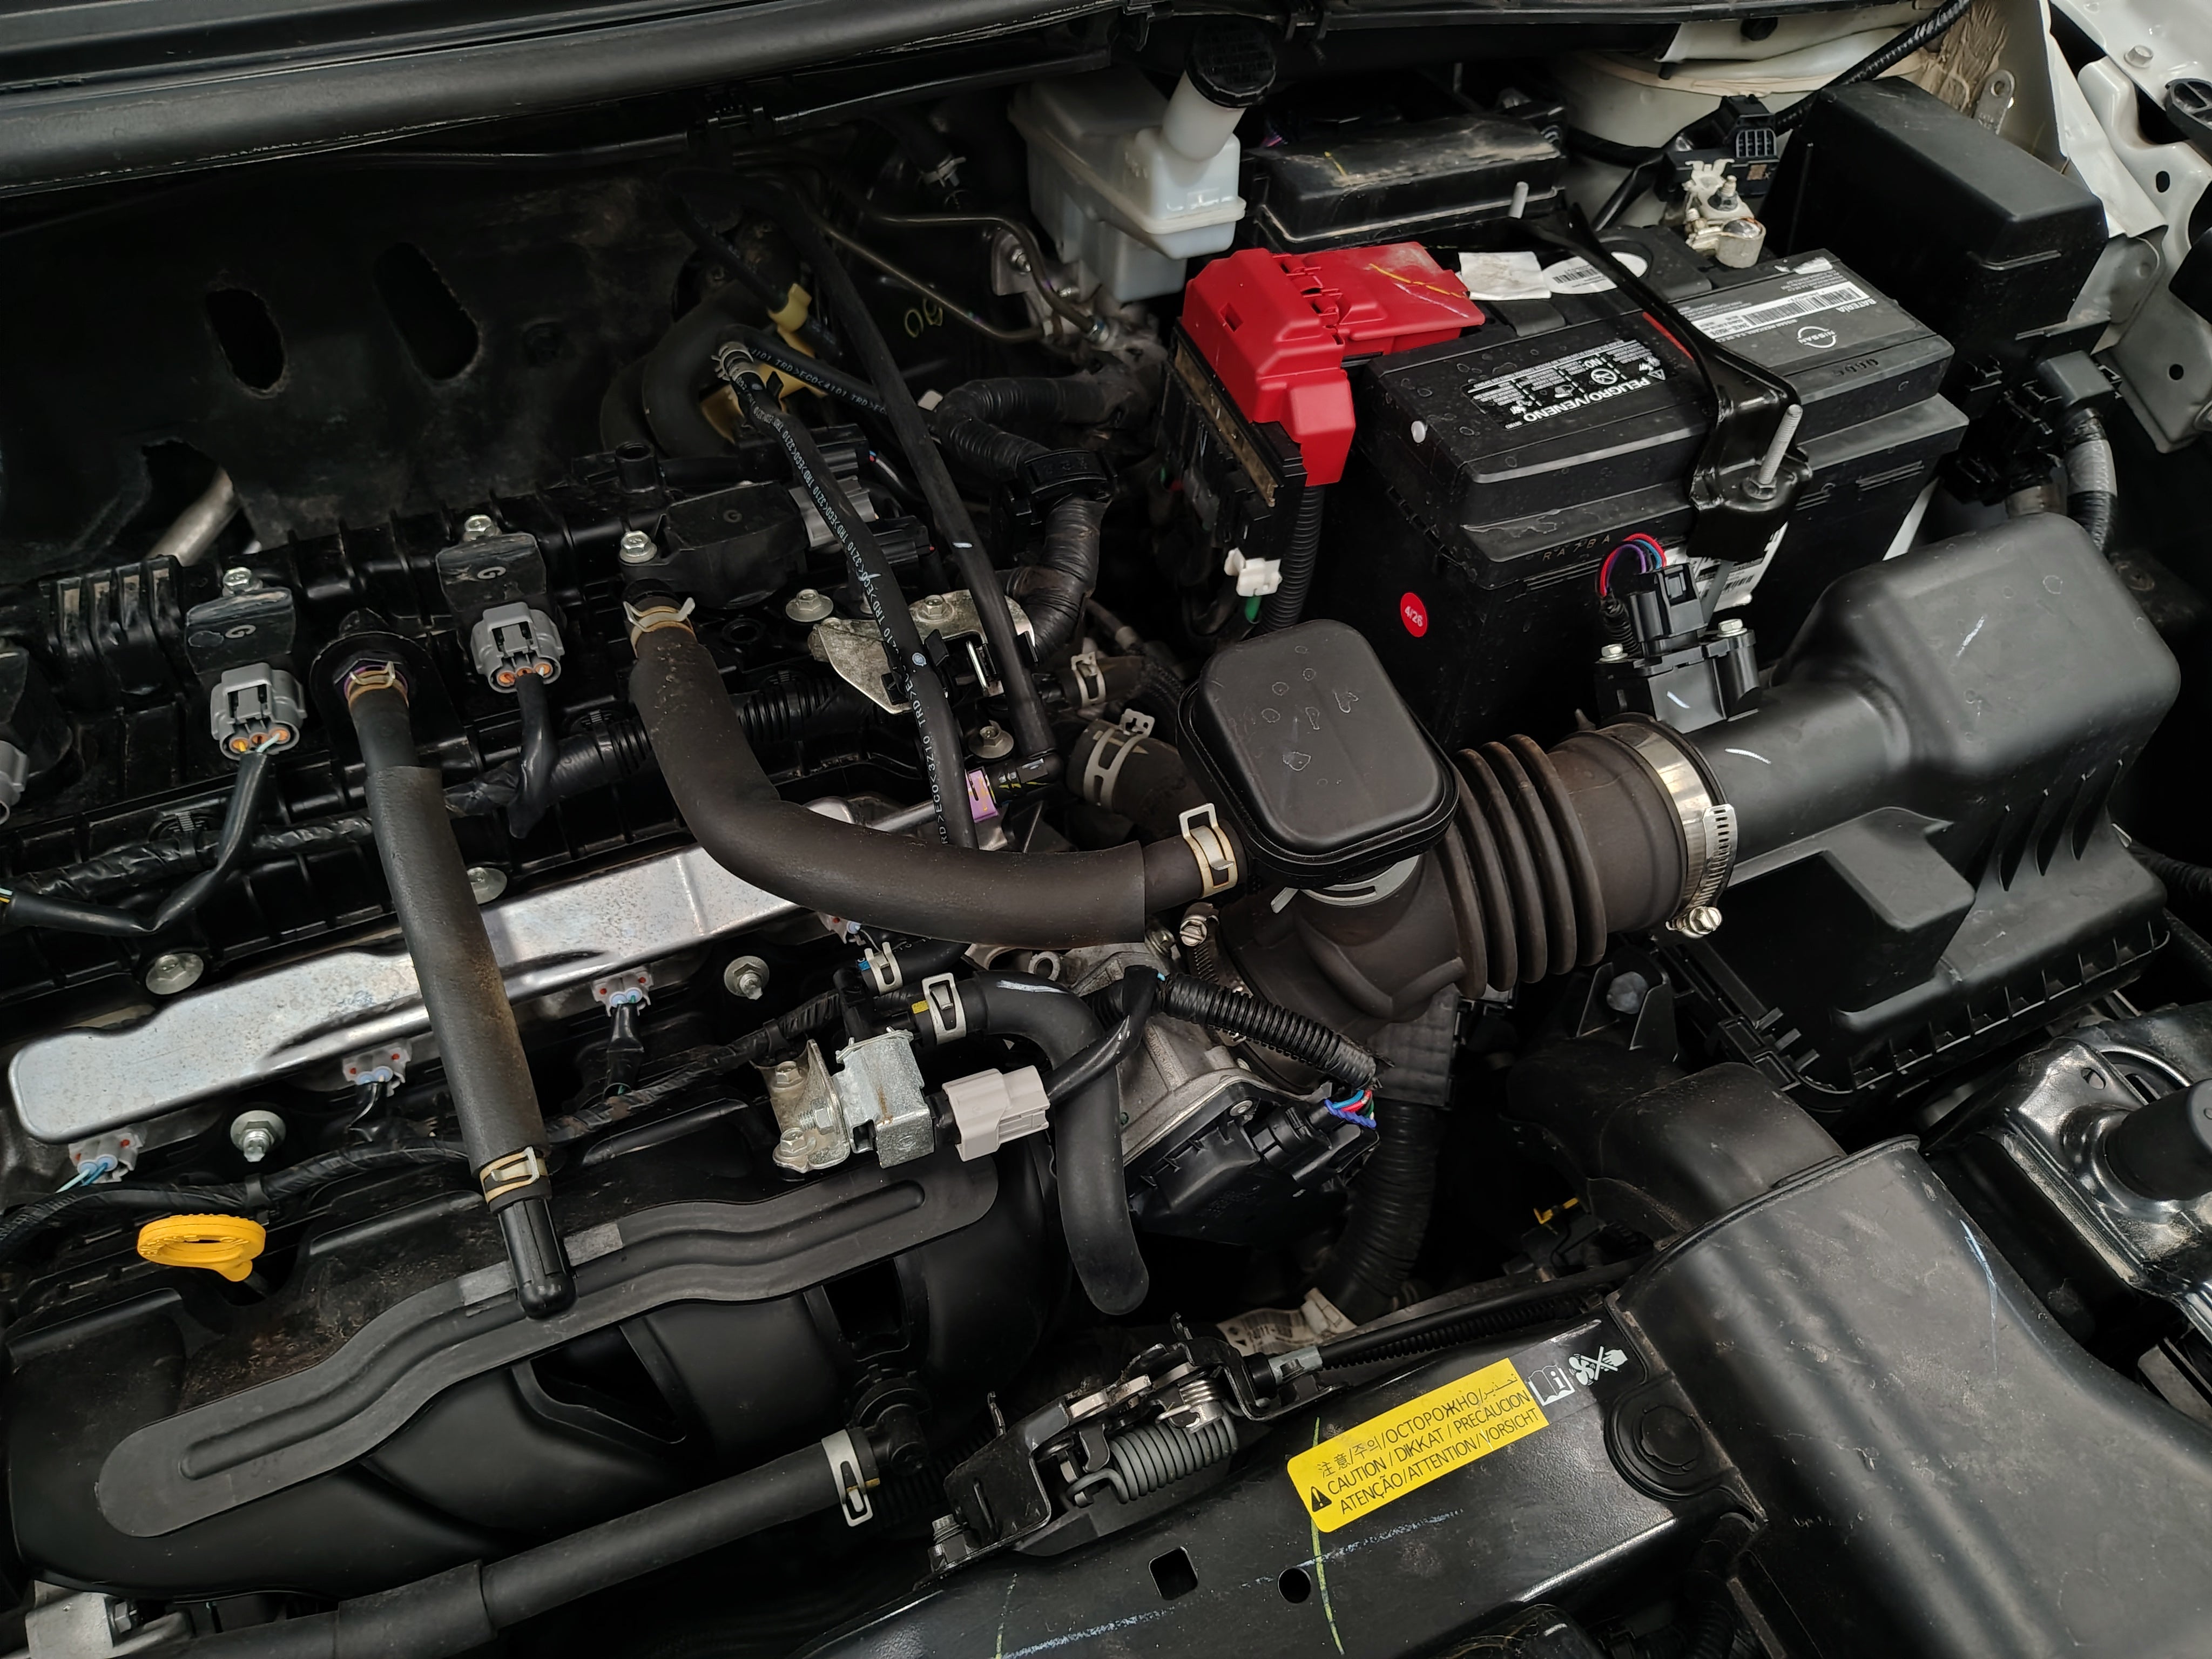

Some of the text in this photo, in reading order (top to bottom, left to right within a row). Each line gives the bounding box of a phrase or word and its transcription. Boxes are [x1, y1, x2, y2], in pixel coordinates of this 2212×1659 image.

[1797, 329, 1836, 345] NISSAN
[1520, 376, 1652, 422] PELIGRO/VENENO
[1405, 605, 1424, 627] 4/26
[921, 734, 948, 844] RD>ECO<3Z10
[1325, 1456, 1388, 1496] CAUTION
[1453, 1388, 1530, 1435] PRECAUCION
